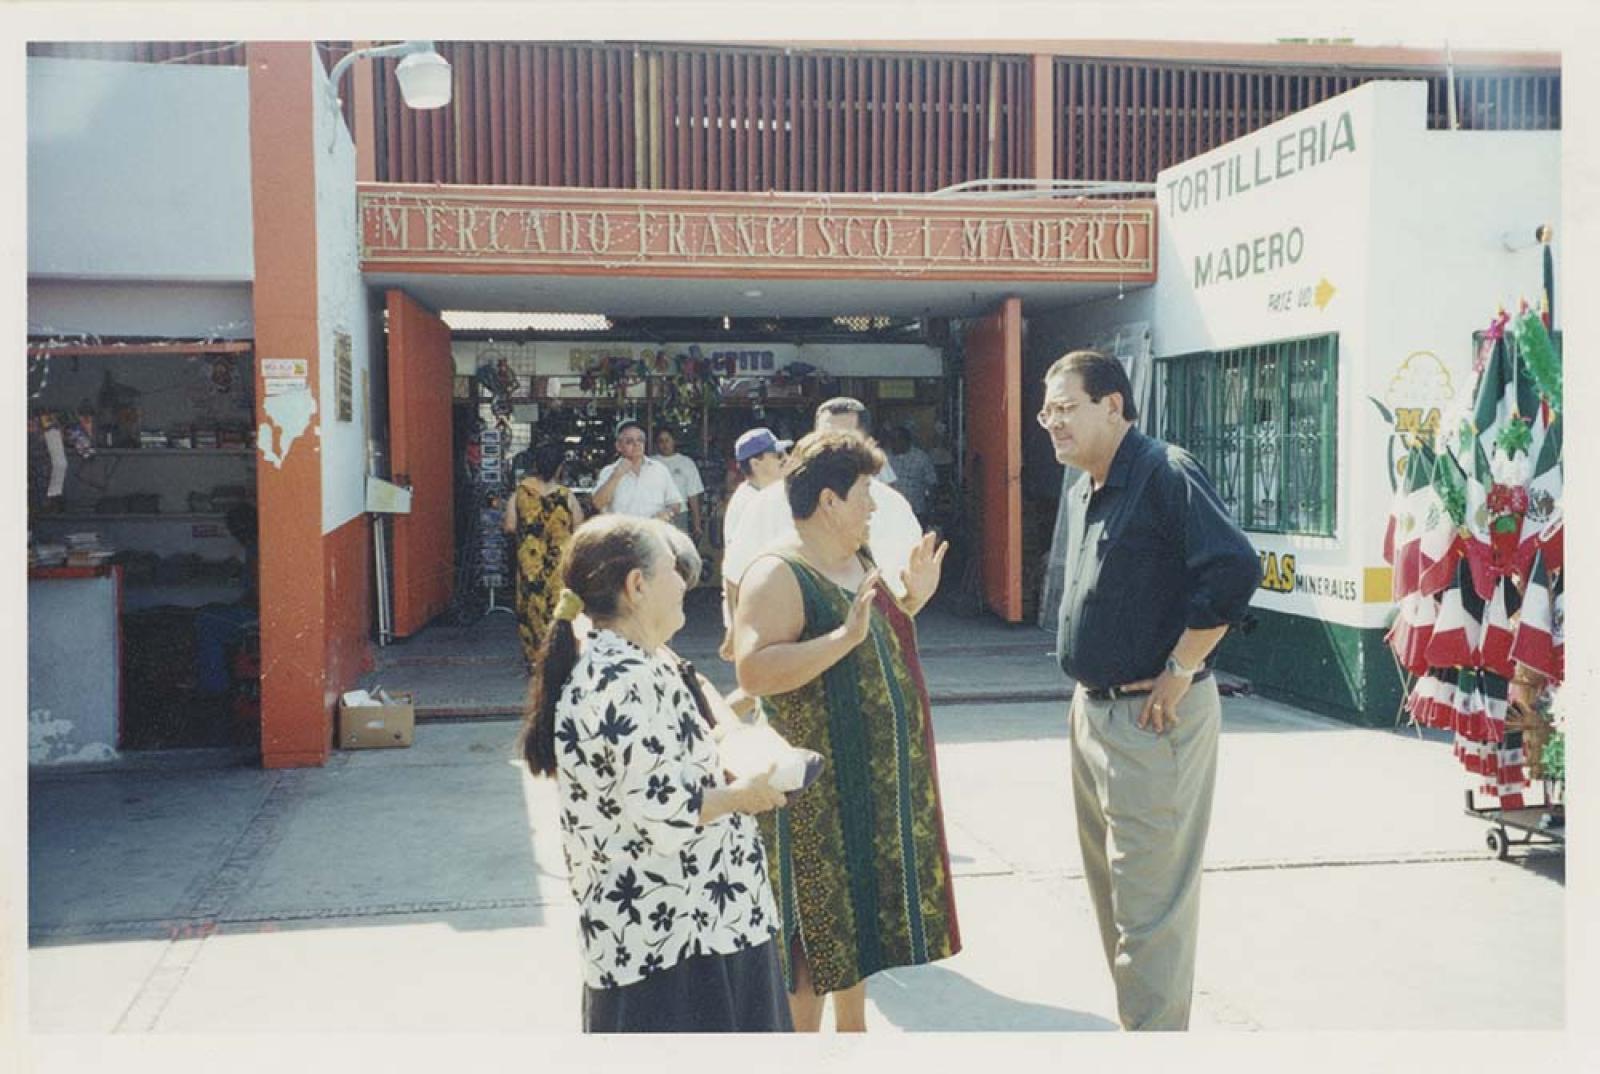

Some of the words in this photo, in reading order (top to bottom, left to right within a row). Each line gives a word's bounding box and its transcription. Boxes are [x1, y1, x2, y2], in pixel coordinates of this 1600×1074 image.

[1166, 111, 1356, 218] TORTILLERIA
[383, 204, 609, 255] MERCADO
[638, 207, 893, 258] FRANCISCO
[962, 217, 1136, 261] MADERO
[1194, 227, 1305, 289] MADERO
[1295, 573, 1357, 601] MINERALES
